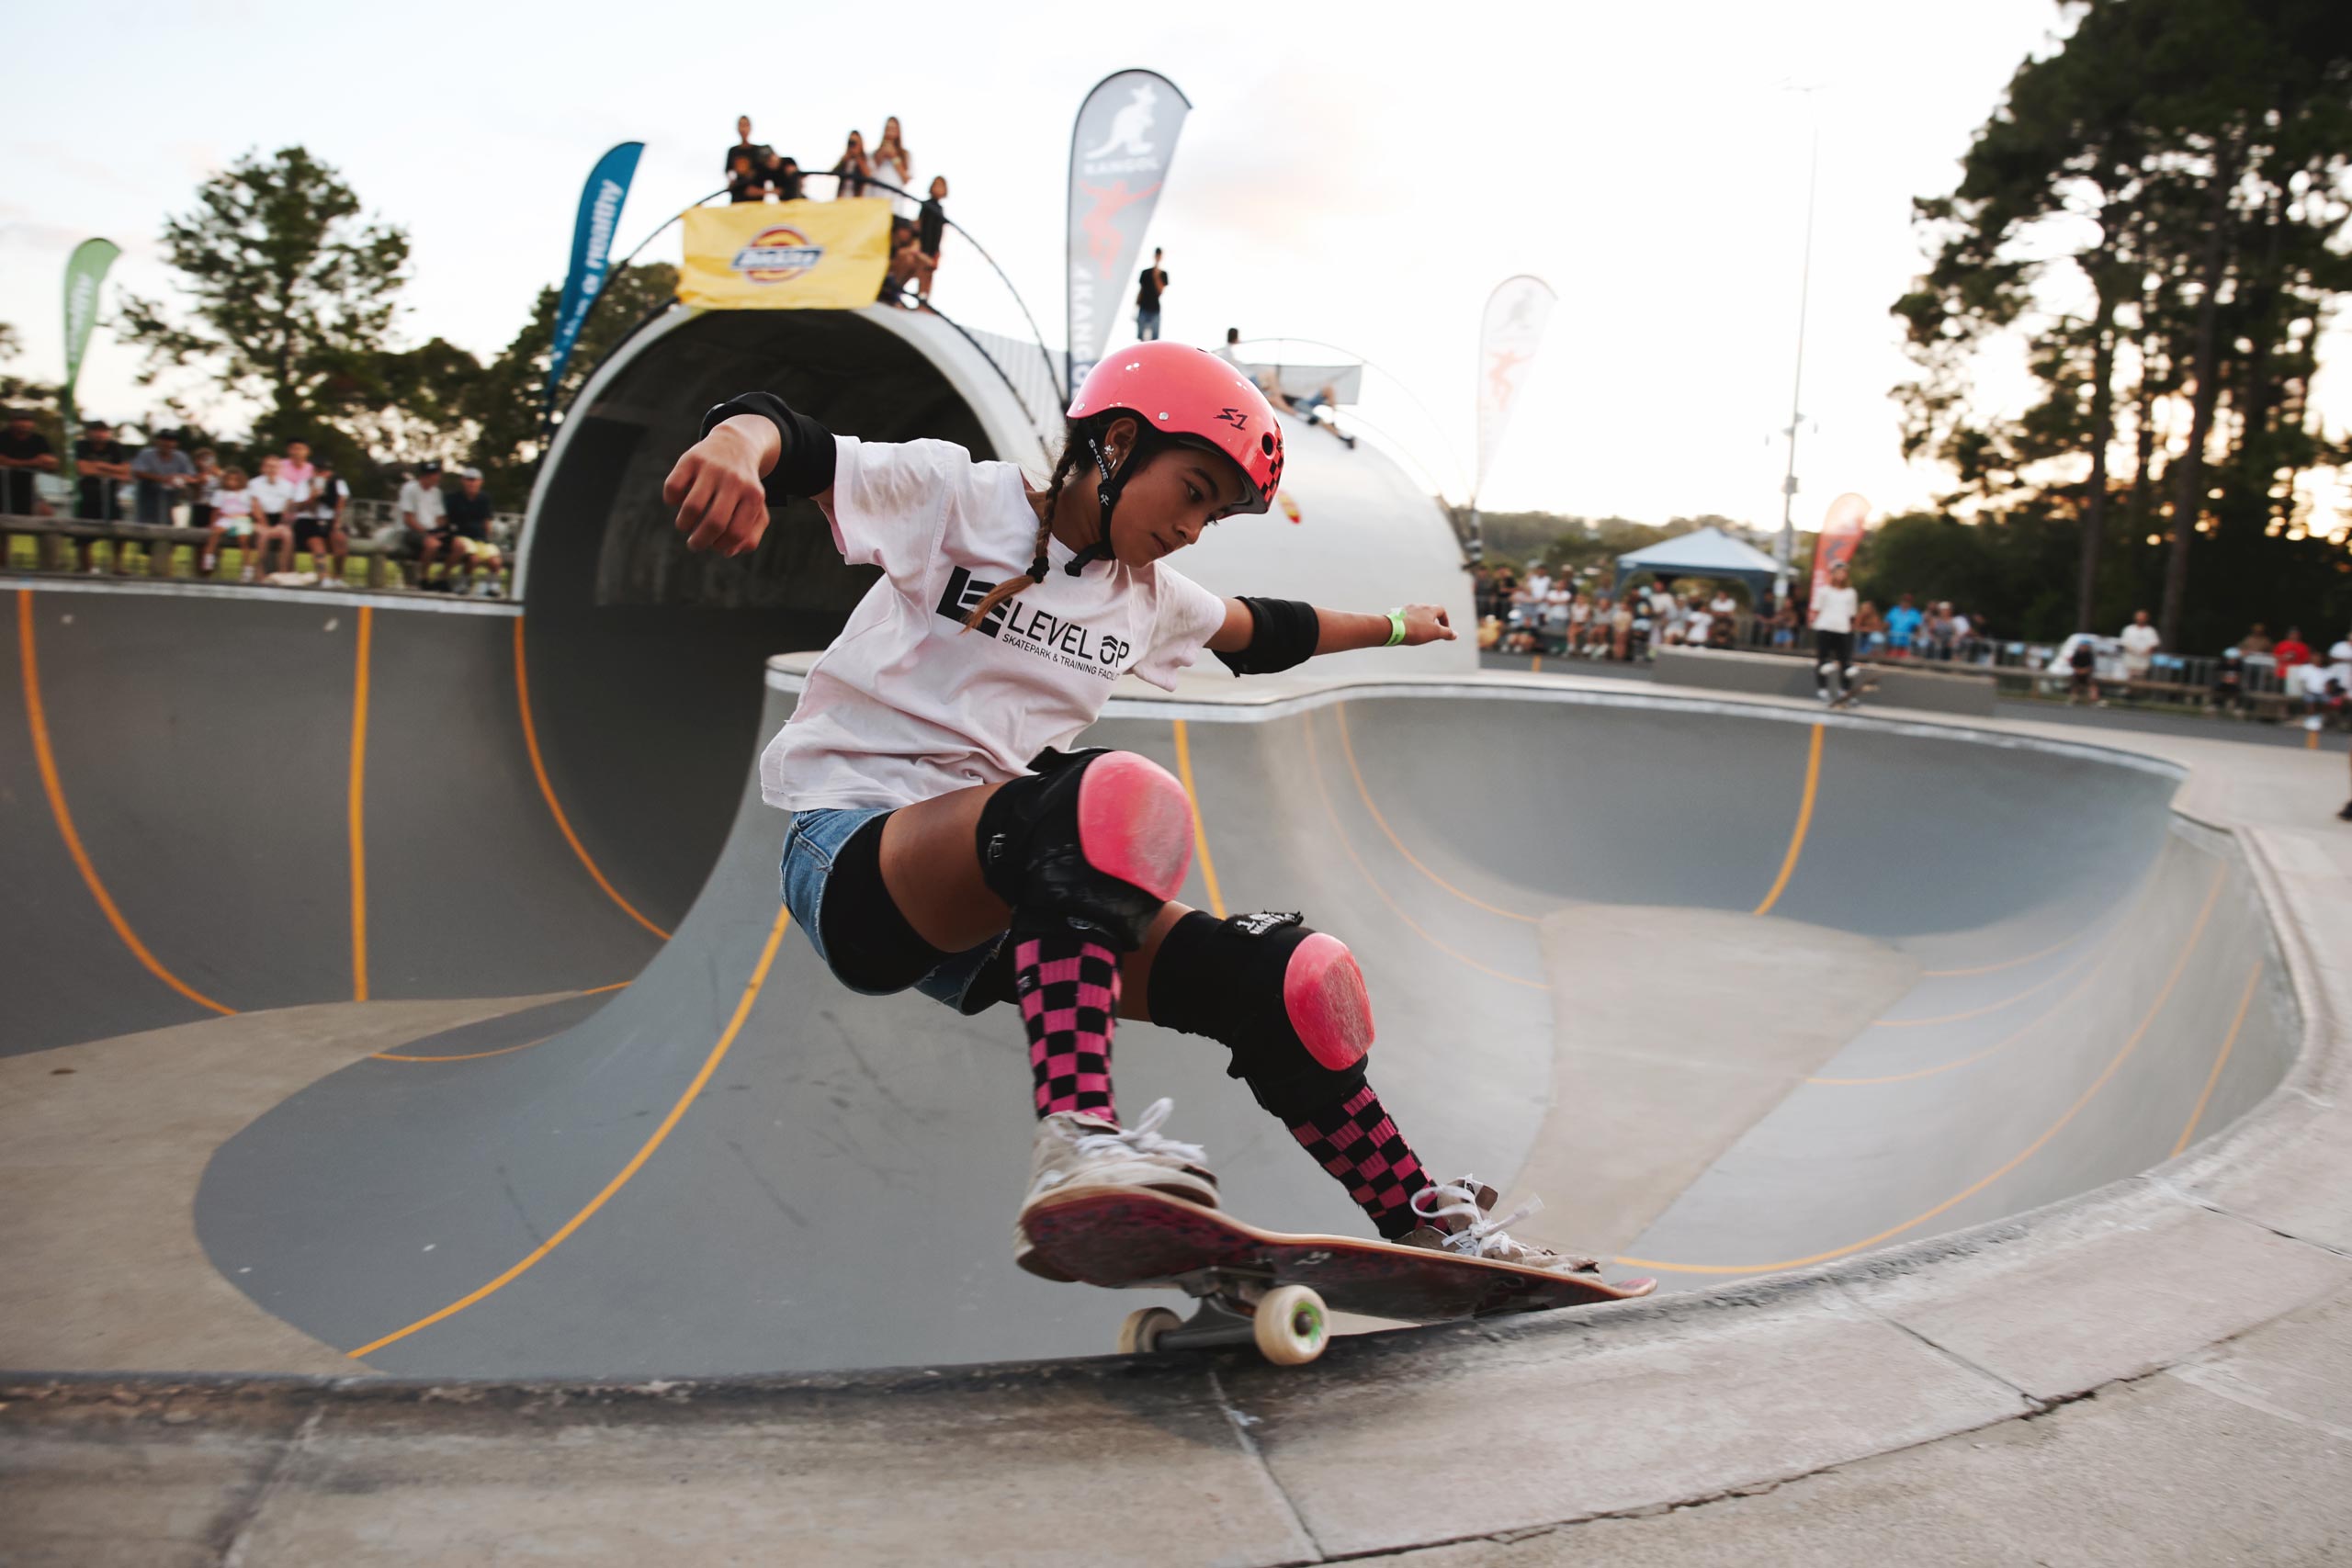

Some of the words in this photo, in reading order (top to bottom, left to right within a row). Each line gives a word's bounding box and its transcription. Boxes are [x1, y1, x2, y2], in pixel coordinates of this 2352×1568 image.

[1001, 633, 1051, 660] SKATEPARK
[1052, 653, 1058, 662] &
[1060, 655, 1097, 675] TRAINING
[1007, 602, 1093, 660] LEVEL
[1099, 635, 1130, 668] UP
